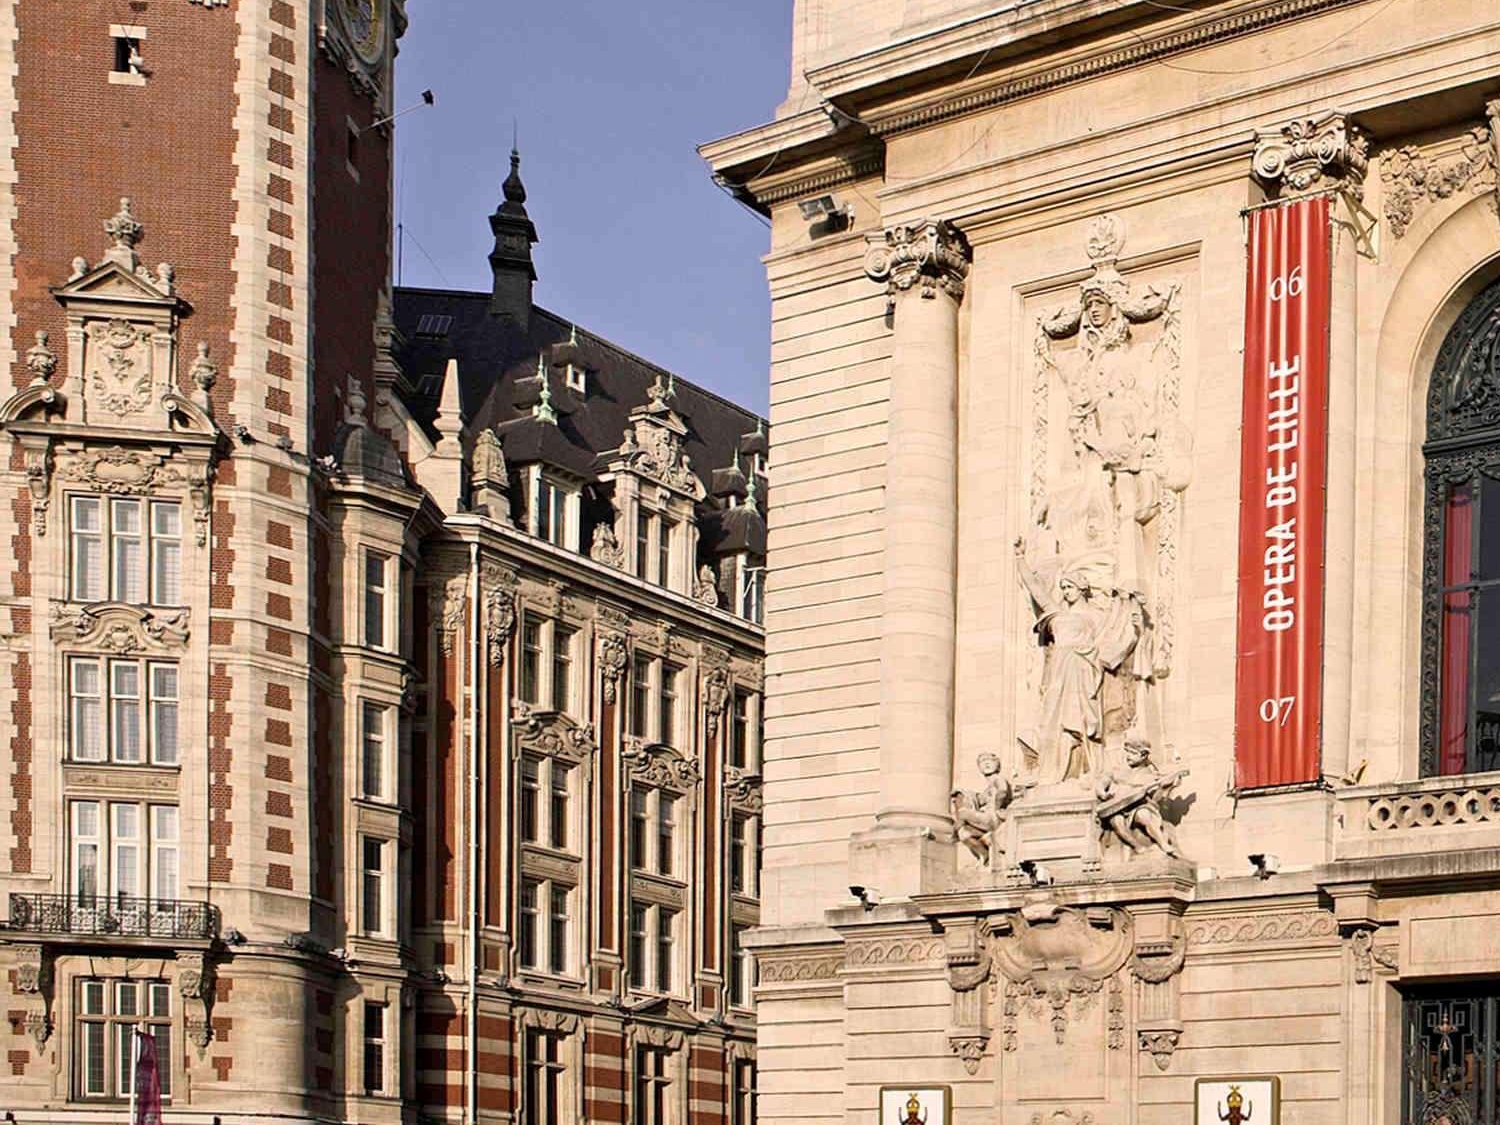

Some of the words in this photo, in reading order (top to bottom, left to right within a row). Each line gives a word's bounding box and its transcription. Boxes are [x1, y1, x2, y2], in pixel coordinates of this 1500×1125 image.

[1269, 266, 1304, 301] 06
[1267, 355, 1300, 453] LILLE
[1265, 462, 1297, 508] DE
[1263, 518, 1296, 632] OPERA
[1260, 696, 1295, 726] 07
